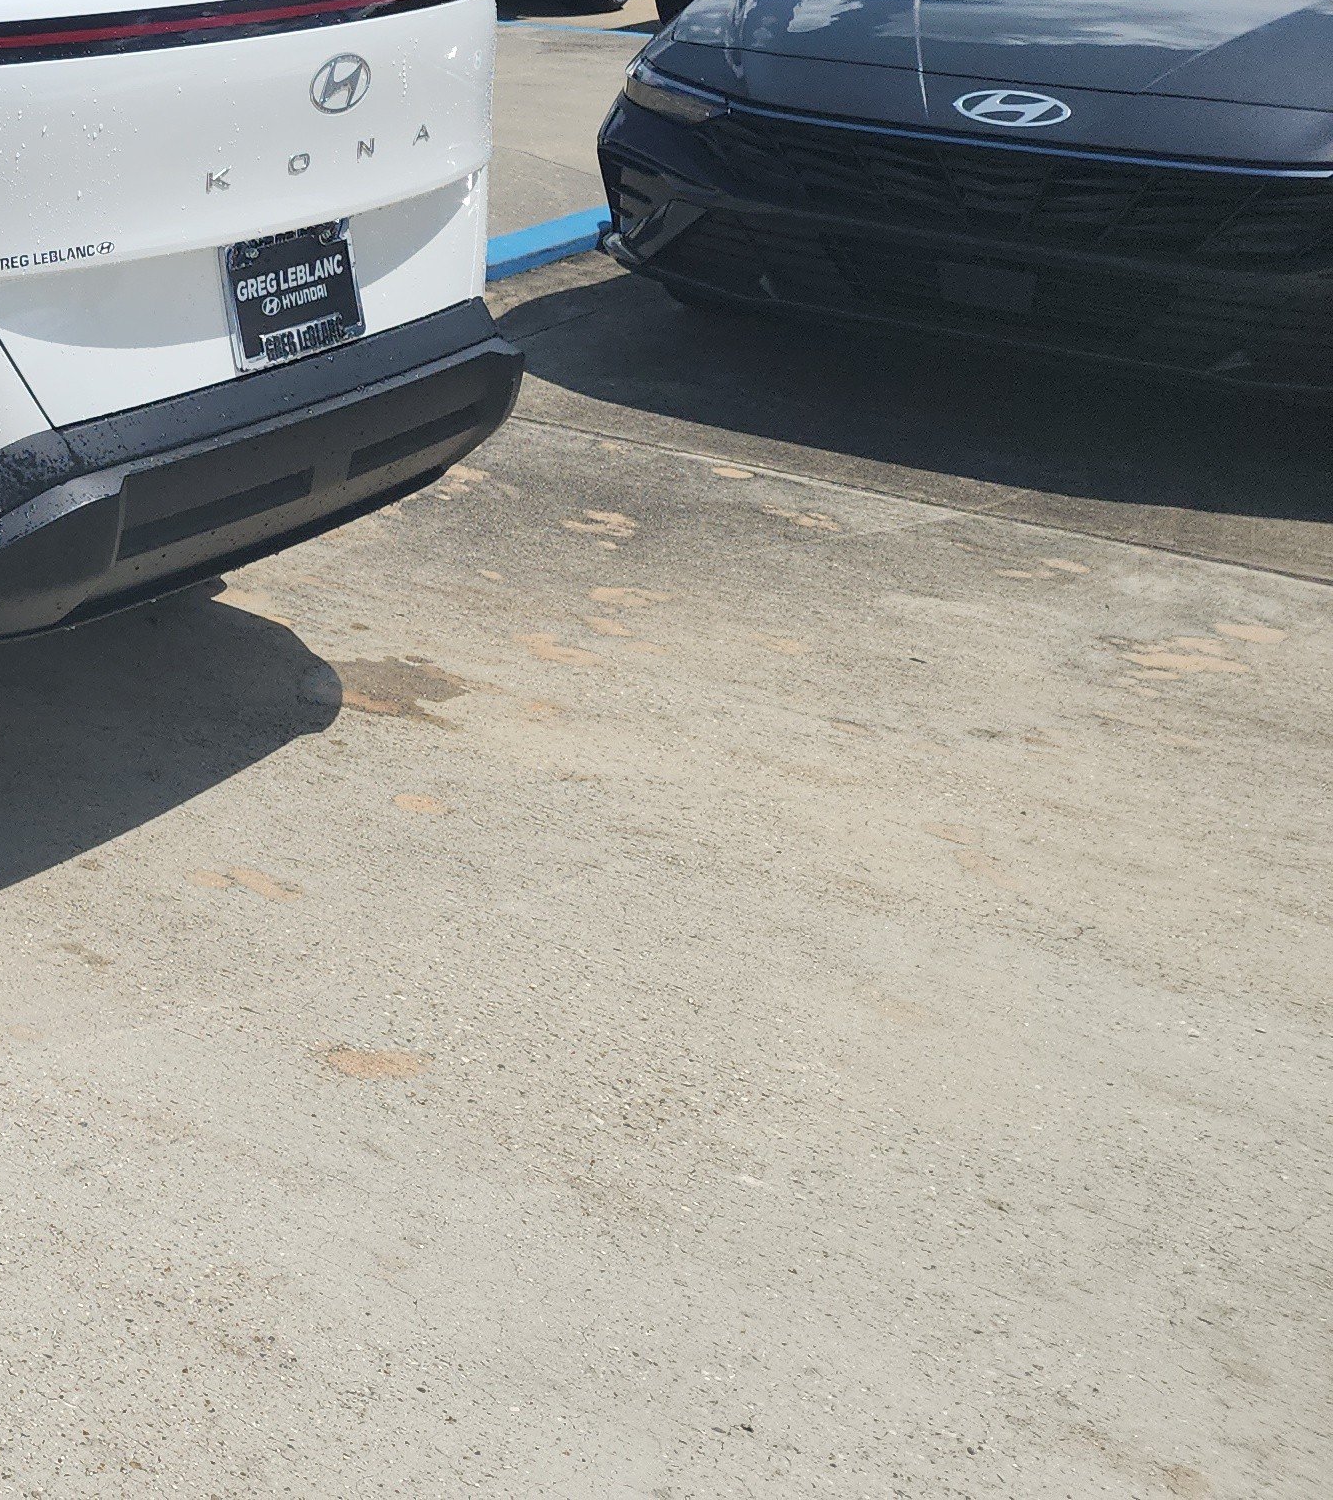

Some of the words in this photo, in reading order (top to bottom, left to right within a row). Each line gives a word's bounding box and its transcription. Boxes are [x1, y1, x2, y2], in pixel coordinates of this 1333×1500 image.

[206, 124, 430, 194] KONA
[236, 272, 277, 302] GREG
[279, 253, 343, 291] LEBLANC
[281, 283, 328, 310] HYUNDAI
